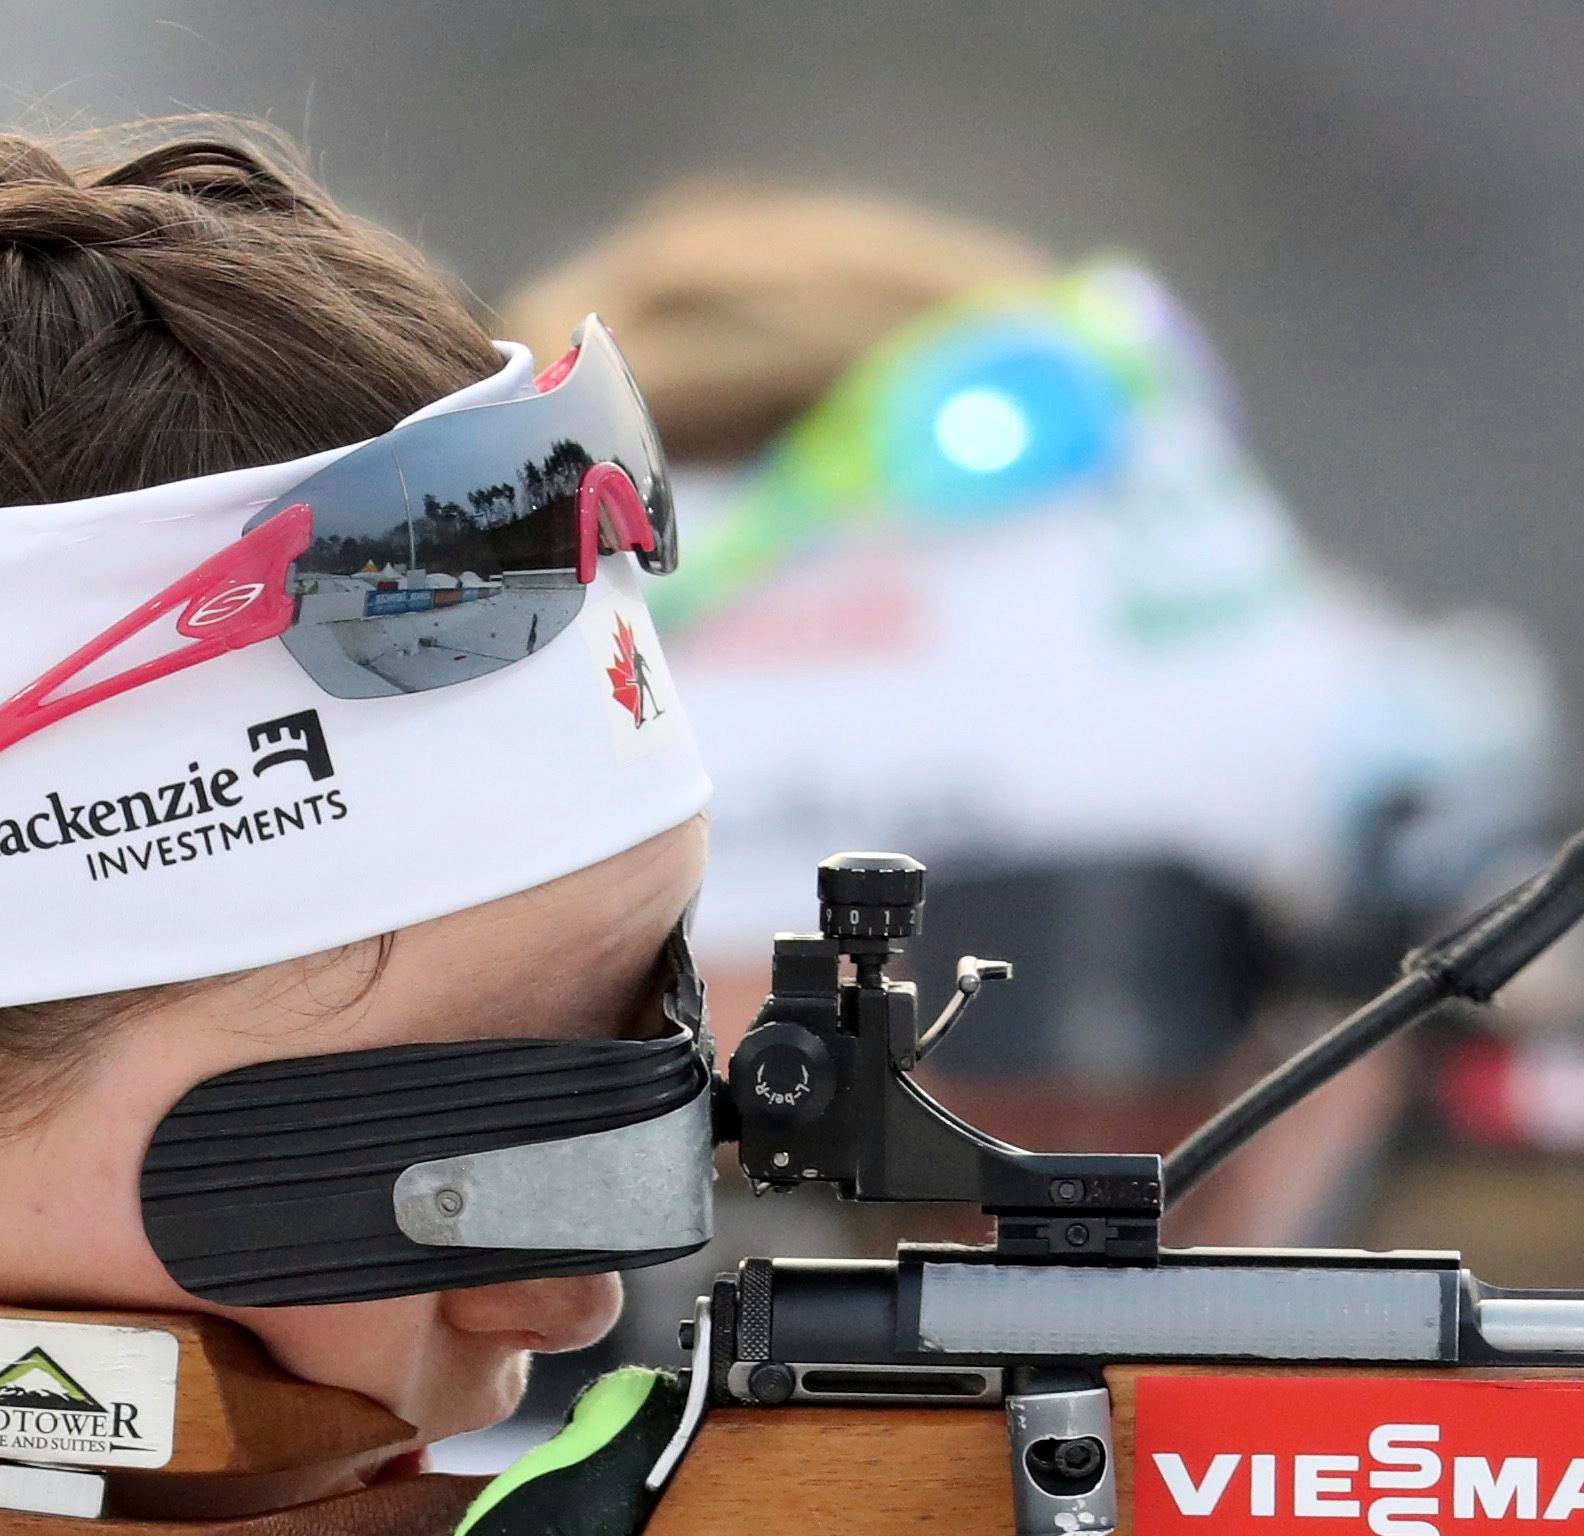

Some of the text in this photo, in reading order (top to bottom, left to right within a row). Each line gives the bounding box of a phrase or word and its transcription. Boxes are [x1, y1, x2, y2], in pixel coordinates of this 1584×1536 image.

[86, 788, 349, 882] INVESTMENTS
[15, 1435, 48, 1450] AND
[51, 1437, 106, 1453] SUITES
